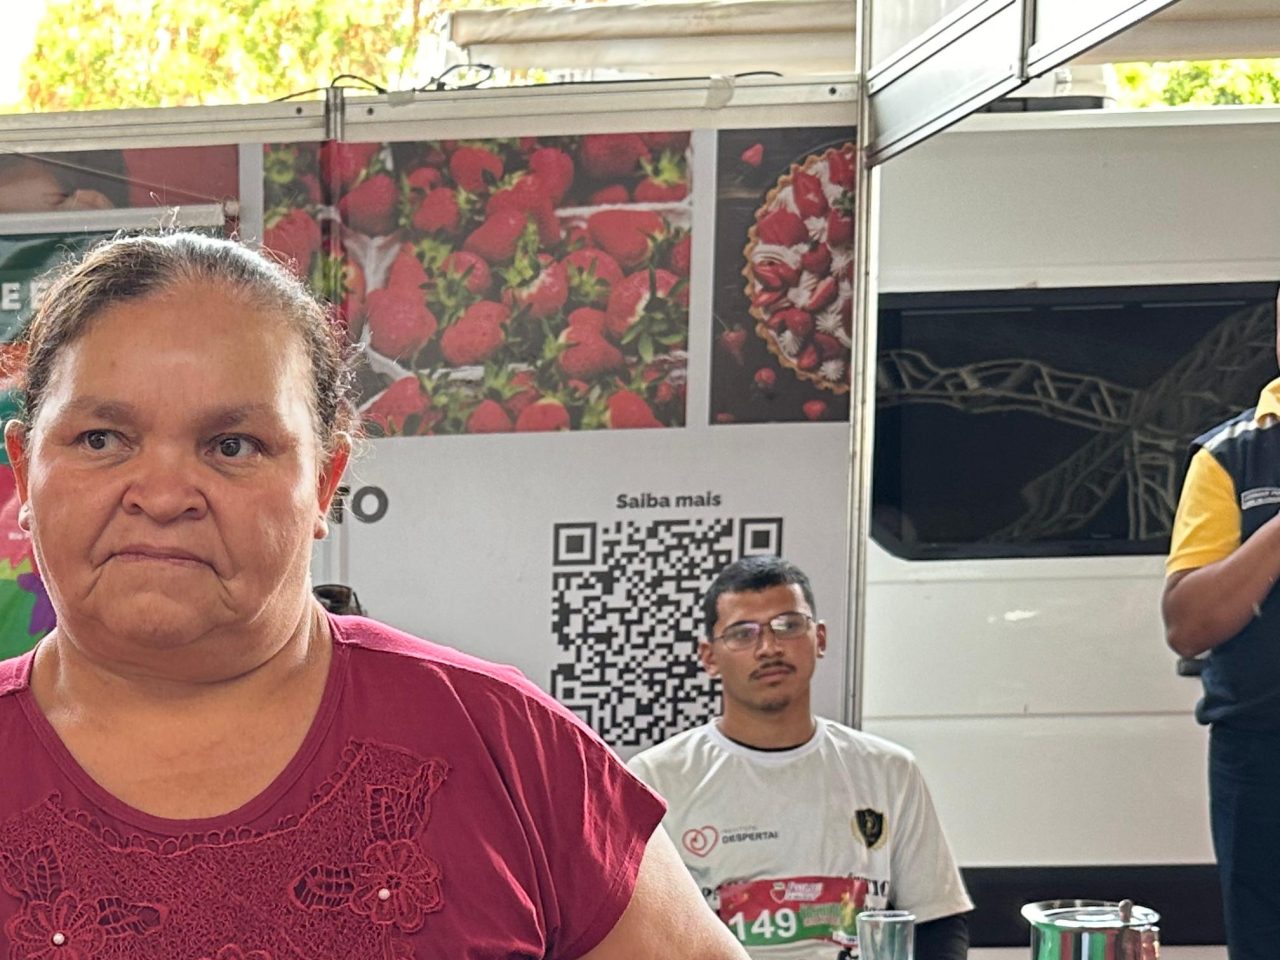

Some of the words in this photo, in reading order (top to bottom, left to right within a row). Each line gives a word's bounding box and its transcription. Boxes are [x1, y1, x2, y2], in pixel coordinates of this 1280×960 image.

[616, 493, 670, 509] Saiba
[675, 490, 722, 508] mais
[729, 907, 797, 941] 149
